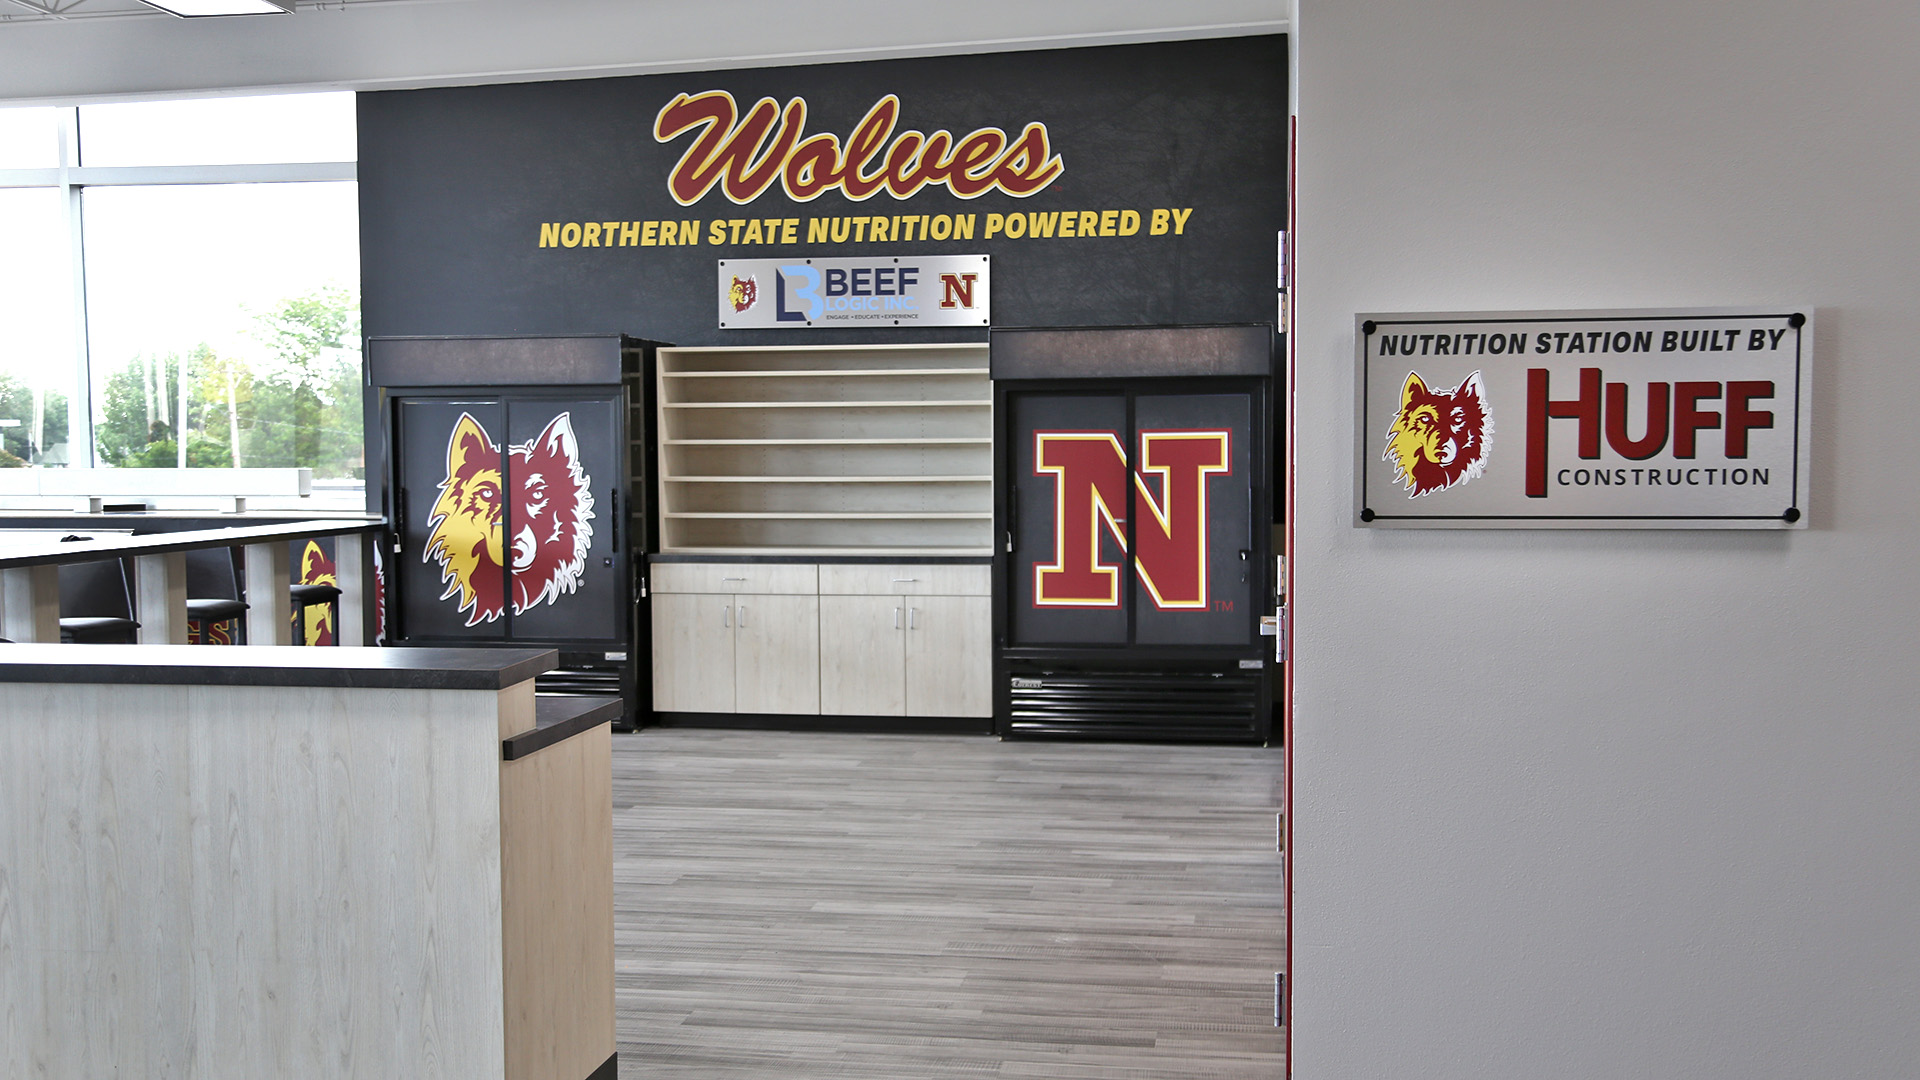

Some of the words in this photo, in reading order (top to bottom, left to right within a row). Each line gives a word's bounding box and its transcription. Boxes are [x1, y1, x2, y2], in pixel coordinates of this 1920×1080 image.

[653, 90, 1064, 206] Wolves
[539, 219, 701, 248] NORTHERN
[708, 218, 800, 245] STATE
[806, 213, 976, 244] NUTRITION
[984, 209, 1141, 240] POWERED
[1149, 207, 1194, 236] BY
[826, 267, 920, 296] BEEF
[939, 272, 979, 310] N
[826, 296, 880, 311] LOGIC
[884, 295, 920, 311] INC.
[1379, 332, 1528, 356] NUTRITION
[1535, 331, 1653, 354] STATION
[1661, 330, 1741, 353] BUILT
[1747, 328, 1787, 351] BY
[1525, 367, 1775, 498] HUFF
[1557, 468, 1770, 487] CONSTRUCTION
[1032, 428, 1233, 612] N
[1213, 600, 1234, 612] TM
